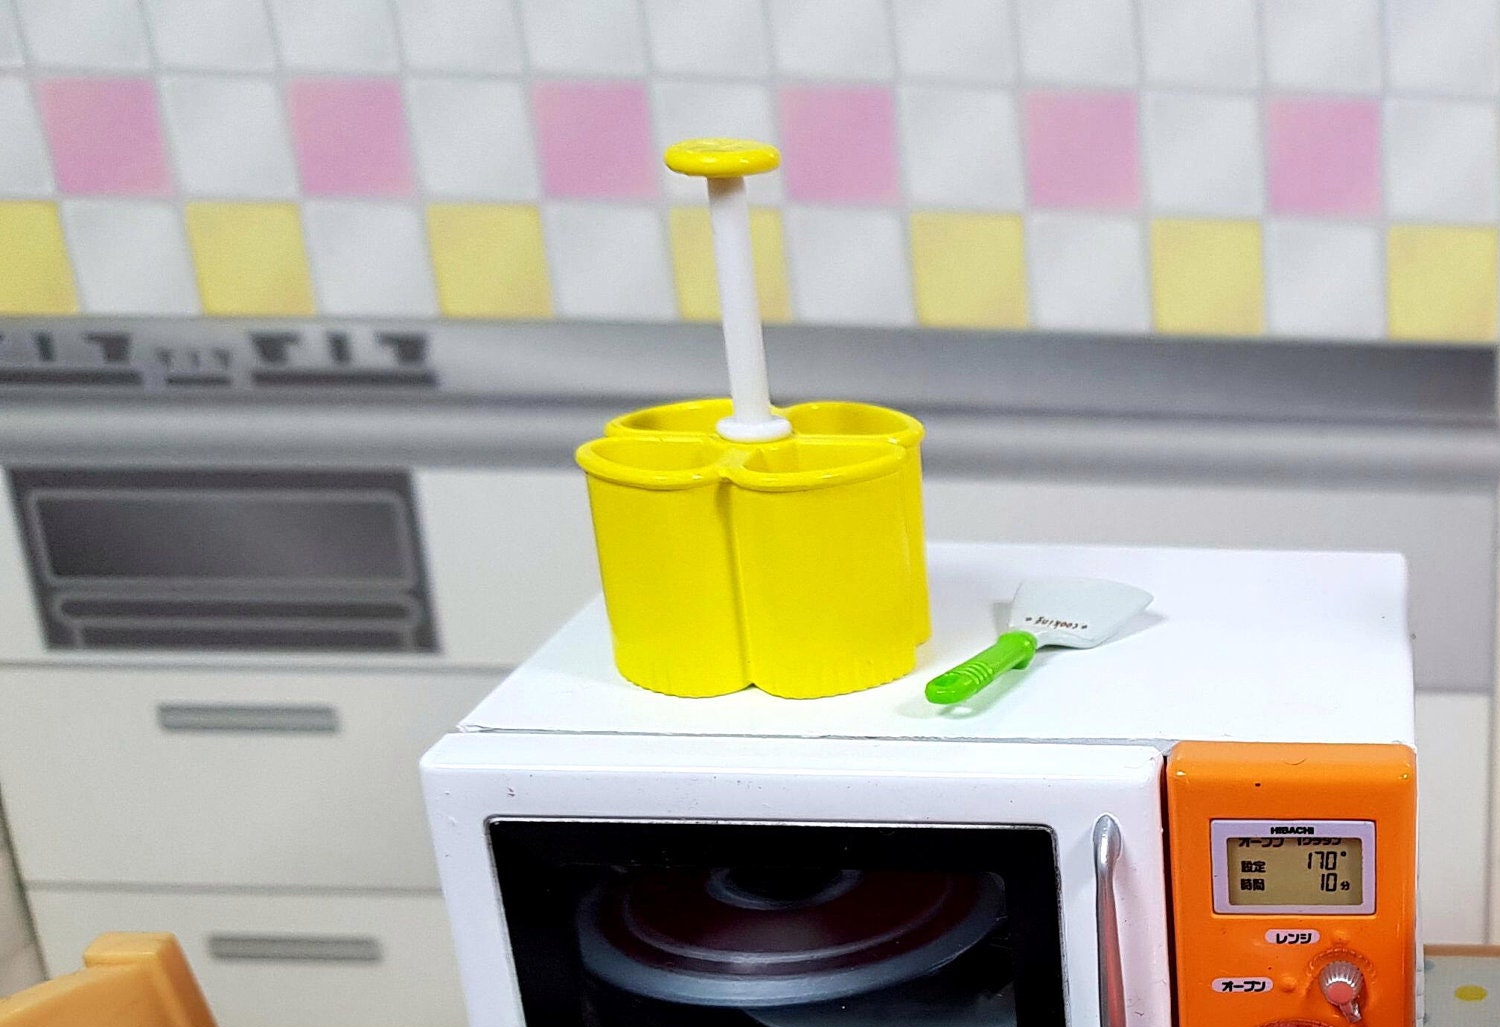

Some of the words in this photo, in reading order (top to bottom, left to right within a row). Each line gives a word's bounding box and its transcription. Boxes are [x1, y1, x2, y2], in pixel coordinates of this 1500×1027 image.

[1035, 616, 1079, 629] cooking
[1270, 826, 1315, 835] HIBACHI
[1241, 861, 1266, 873] 設定
[1240, 878, 1265, 891] 時間
[1275, 932, 1312, 944] レンジ
[1221, 981, 1267, 992] オーブン
